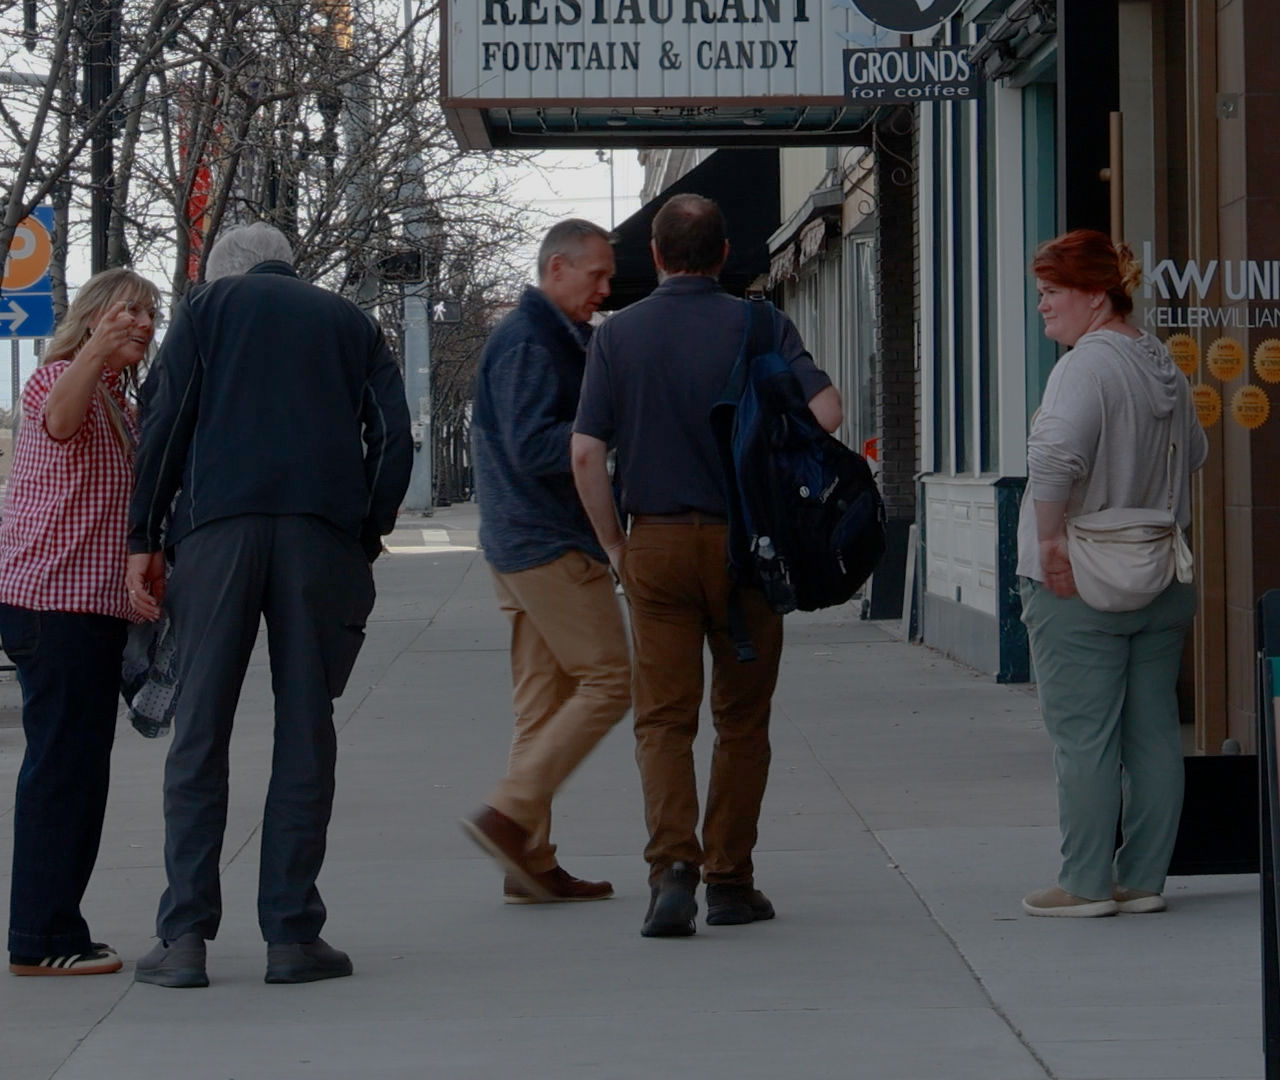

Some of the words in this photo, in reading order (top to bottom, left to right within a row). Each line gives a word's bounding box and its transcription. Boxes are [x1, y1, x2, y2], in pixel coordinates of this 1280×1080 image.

[483, 41, 640, 71] FOUNTAIN
[659, 41, 682, 70] &
[697, 40, 798, 69] CANDY
[849, 50, 970, 84] GROUNDS
[851, 86, 885, 98] for
[894, 84, 970, 97] coffee
[3, 226, 37, 278] P
[1143, 241, 1218, 299] kw
